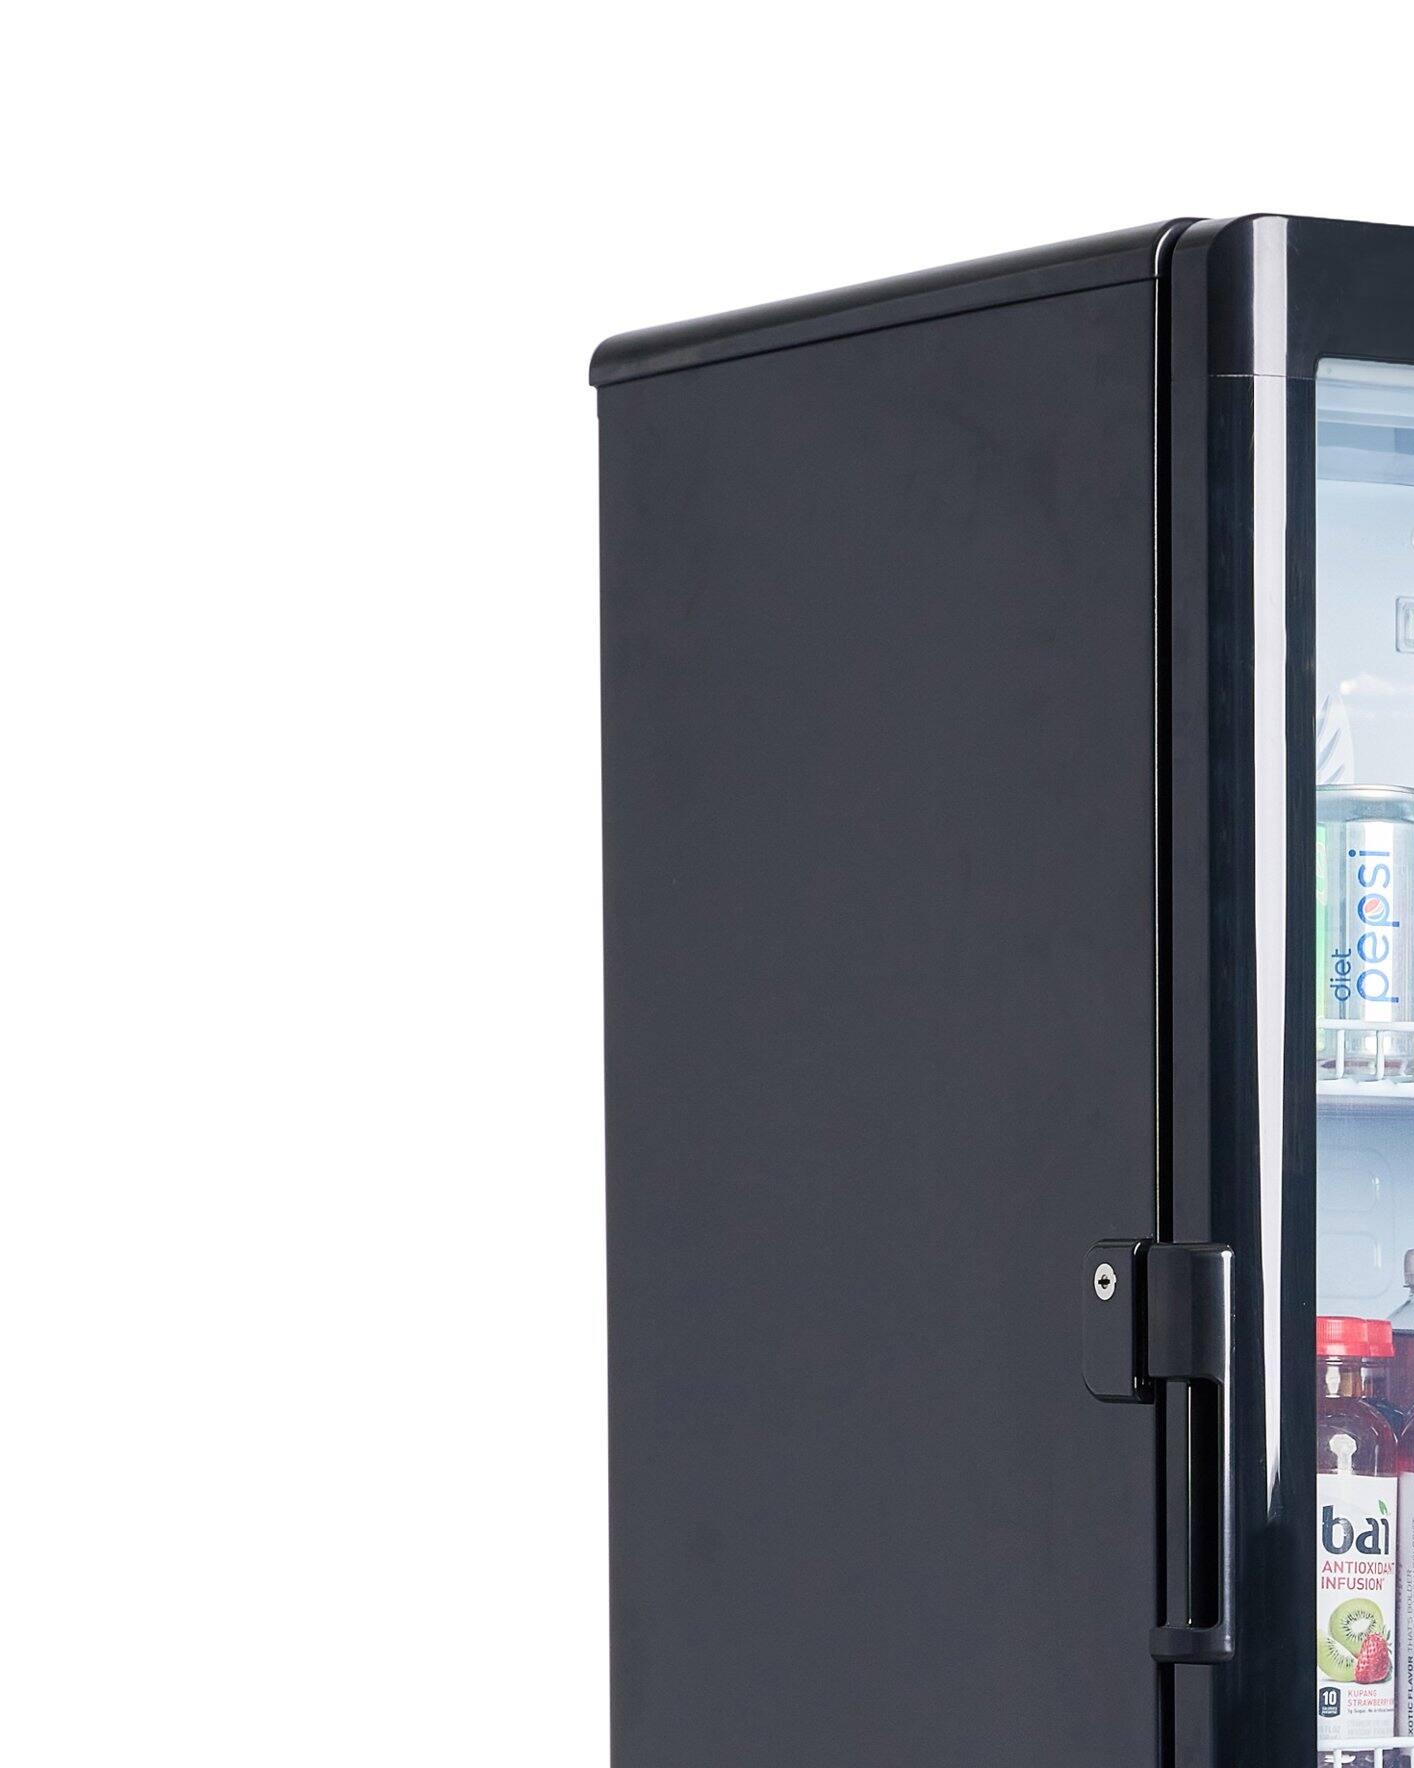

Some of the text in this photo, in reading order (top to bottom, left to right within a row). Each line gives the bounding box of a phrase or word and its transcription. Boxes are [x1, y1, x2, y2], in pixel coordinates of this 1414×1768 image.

[1349, 850, 1400, 1002] pepsi
[1330, 948, 1351, 1001] diet
[1322, 1500, 1390, 1555] bai
[1322, 1561, 1394, 1574] ANTIOXIDANT
[1322, 1577, 1382, 1590] INFUSION
[1322, 1691, 1336, 1705] 10
